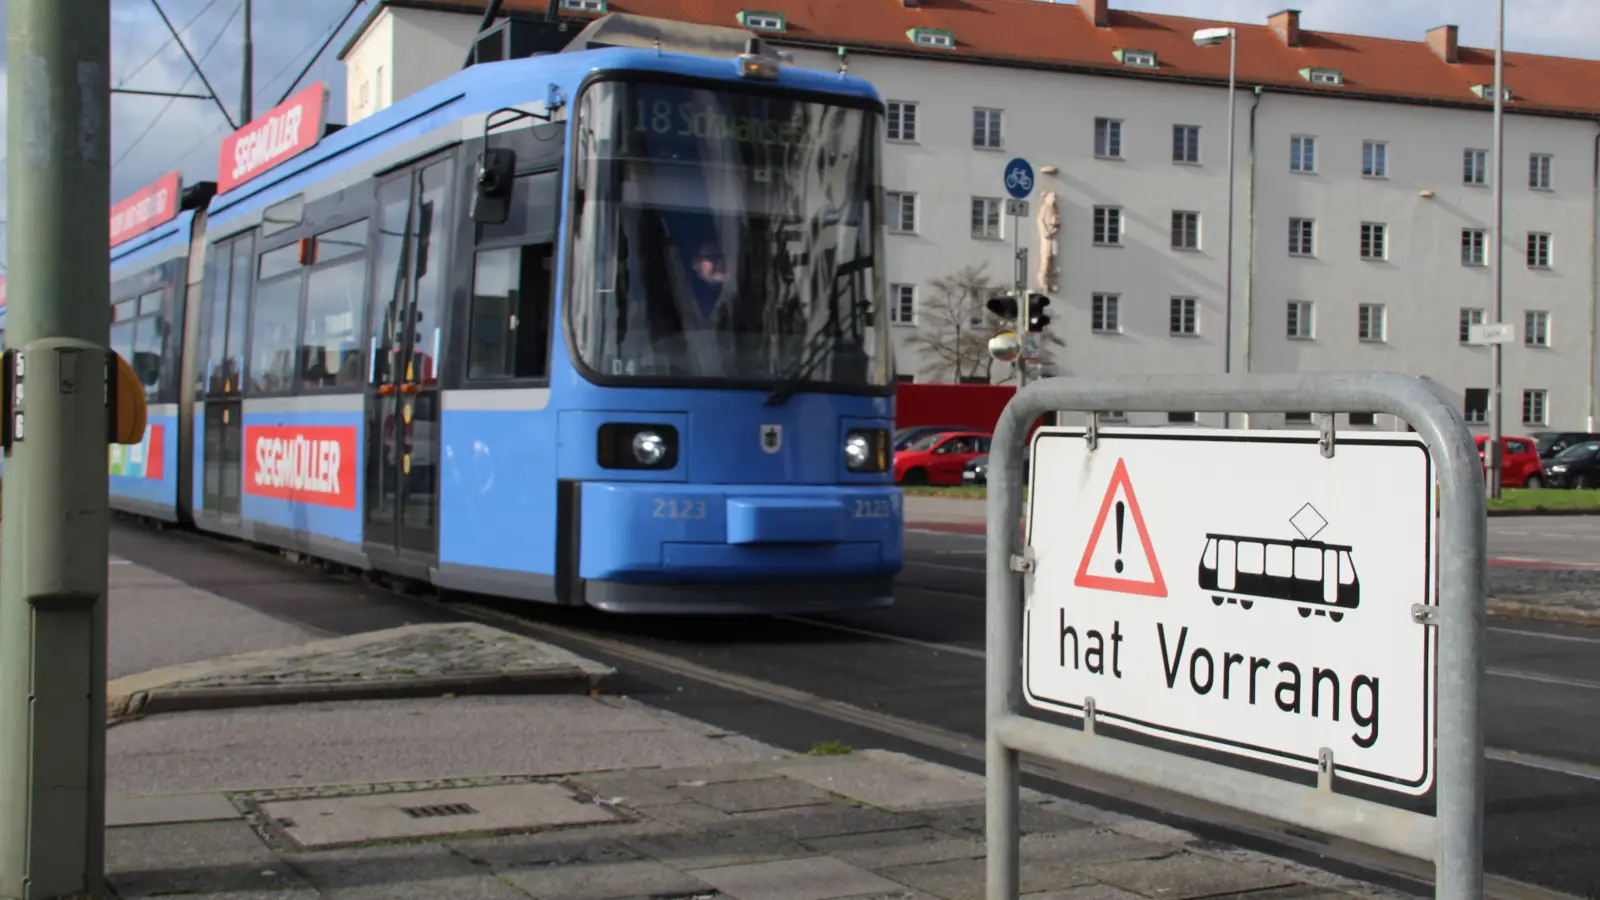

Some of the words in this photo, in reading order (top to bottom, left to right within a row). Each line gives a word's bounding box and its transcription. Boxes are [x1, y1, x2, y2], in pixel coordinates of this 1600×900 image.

[232, 104, 302, 179] SEGMÜLLER
[635, 102, 671, 134] 18
[255, 433, 341, 495] SEGMÜLLER
[652, 498, 706, 519] 2123
[854, 500, 890, 518] 2123
[1059, 607, 1123, 679] hat
[1156, 622, 1380, 749] Vorrang
